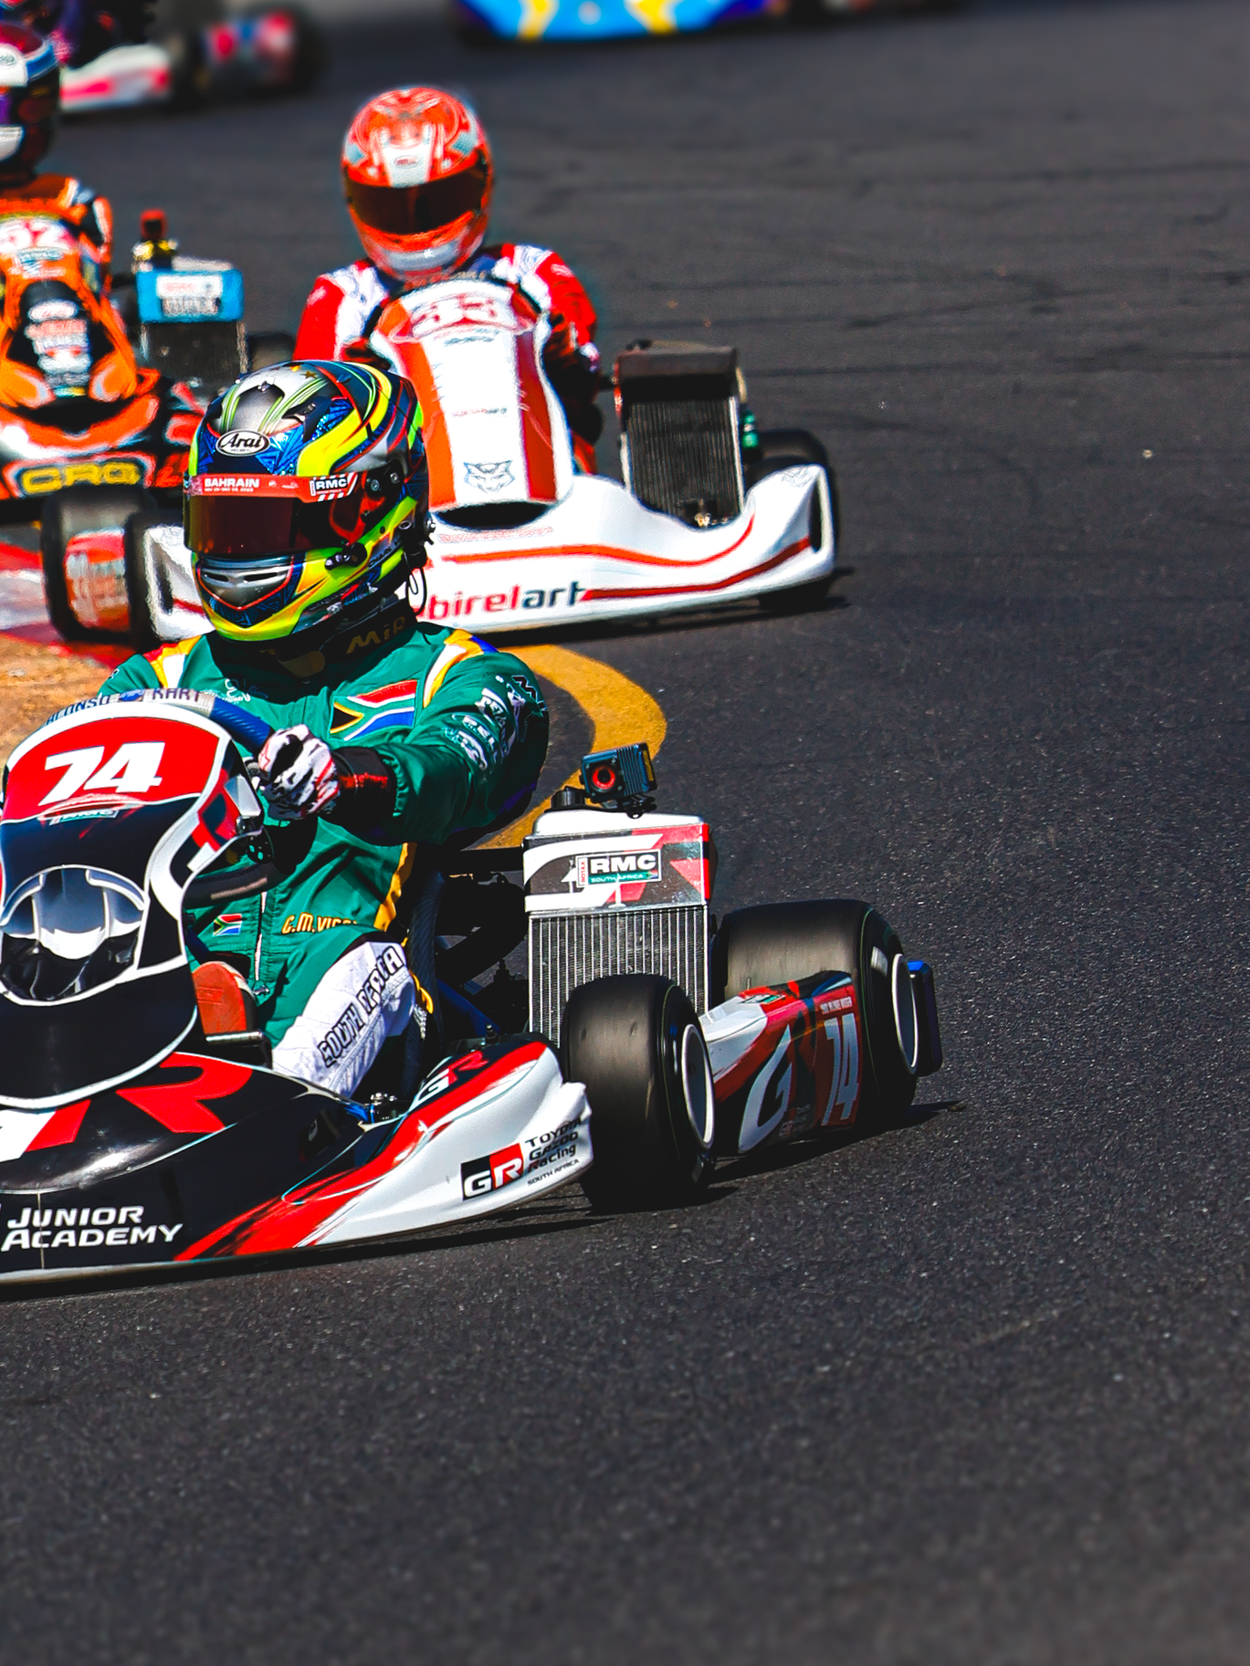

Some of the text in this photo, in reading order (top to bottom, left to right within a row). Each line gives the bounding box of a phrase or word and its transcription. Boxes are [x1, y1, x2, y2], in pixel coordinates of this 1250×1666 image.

[222, 432, 263, 449] Arai
[204, 478, 260, 488] BAHRAIN
[315, 478, 347, 491] RMC
[428, 580, 586, 620] birelart
[37, 741, 166, 807] 74
[589, 854, 657, 875] RMC
[590, 873, 644, 884] SOUTH AFRICA
[819, 1013, 859, 1127] 74
[524, 1116, 583, 1148] TOYOTA
[528, 1131, 579, 1161] GAZOO
[527, 1143, 578, 1174] Racing
[527, 1158, 581, 1187] SOUTH AFRICA
[463, 1156, 523, 1198] GR
[6, 1205, 145, 1230] JUNIOR
[0, 1223, 184, 1253] ACADEMY
